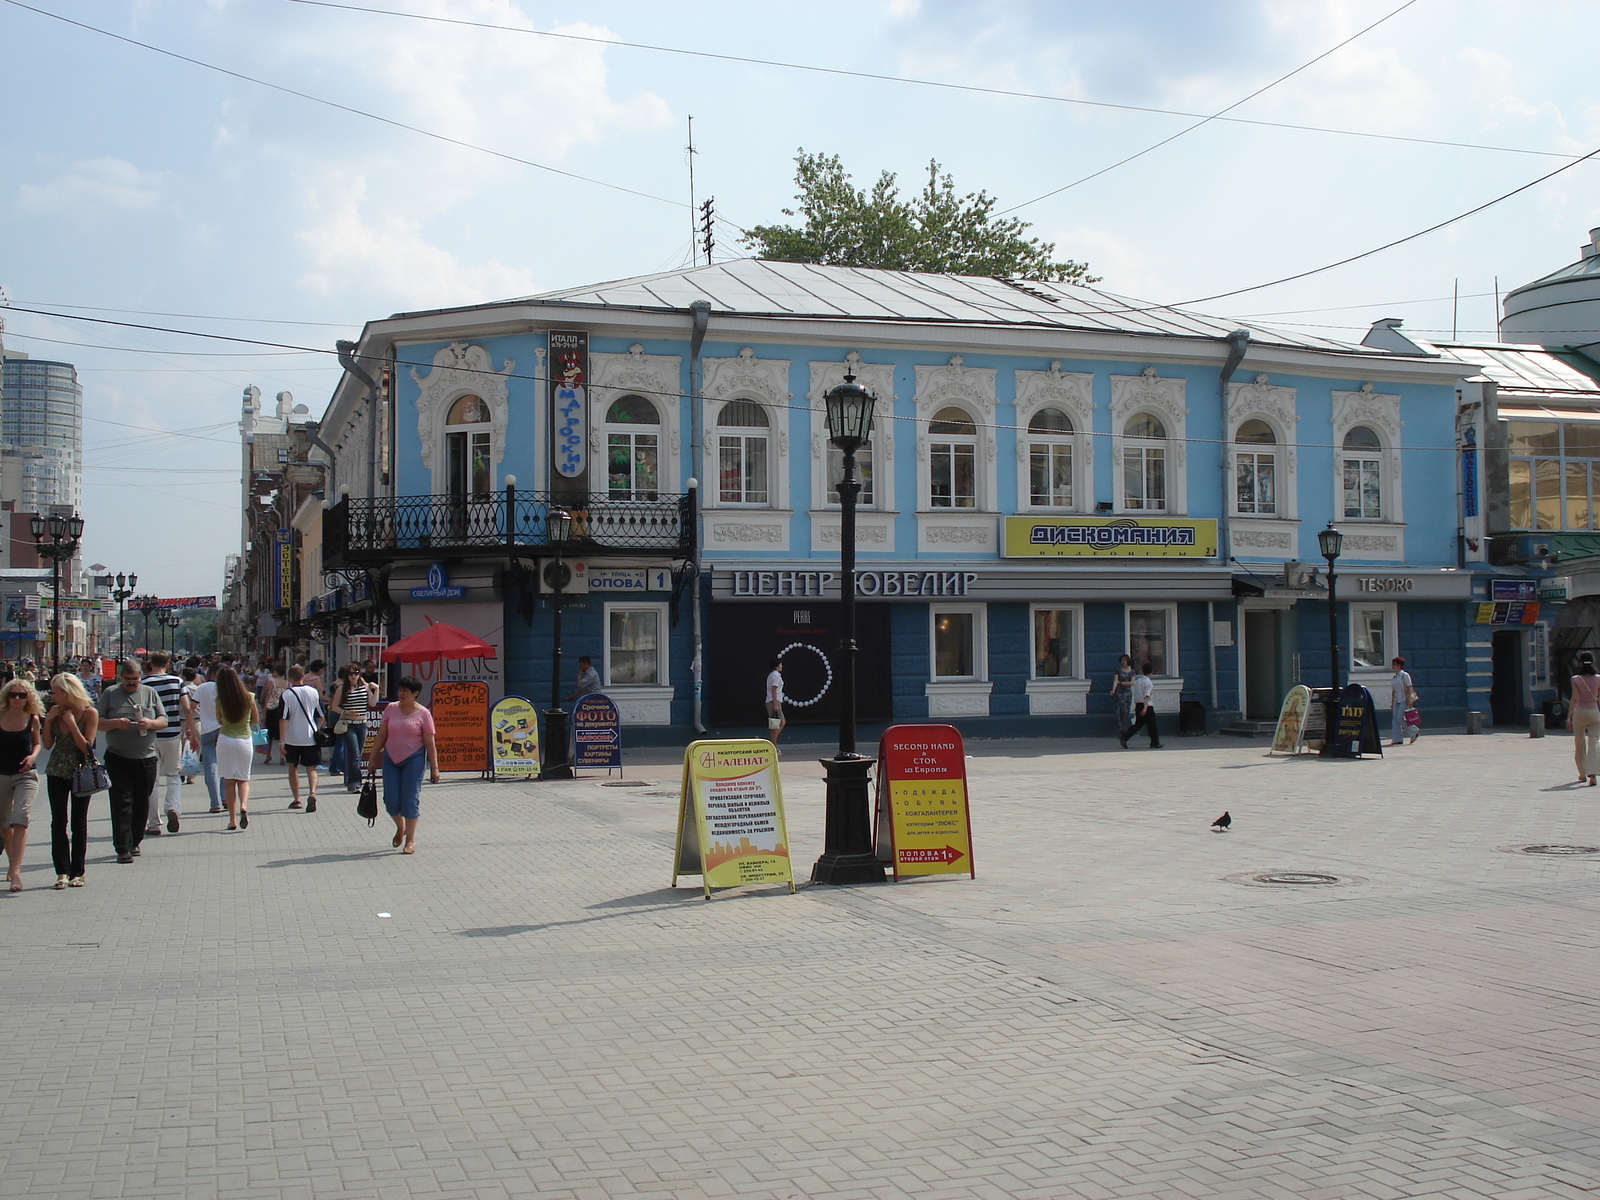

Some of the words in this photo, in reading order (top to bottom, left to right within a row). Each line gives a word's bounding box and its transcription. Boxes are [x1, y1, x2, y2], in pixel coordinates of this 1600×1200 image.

[551, 334, 578, 344] ИТАЛЛ
[559, 388, 581, 473] МАТРОСКИН
[1030, 525, 1195, 547] ДИСКОМАНИЯ
[282, 545, 290, 606] ЭСТЕТИКА
[657, 572, 665, 588] 1
[734, 571, 834, 596] ЦЕНТР
[855, 571, 978, 596] ЮВЕЛИР
[1359, 578, 1415, 592] TESORO
[576, 711, 617, 721] ФОТО
[893, 743, 928, 751] SECOND
[931, 743, 954, 751] HAND
[914, 766, 948, 774] Европы
